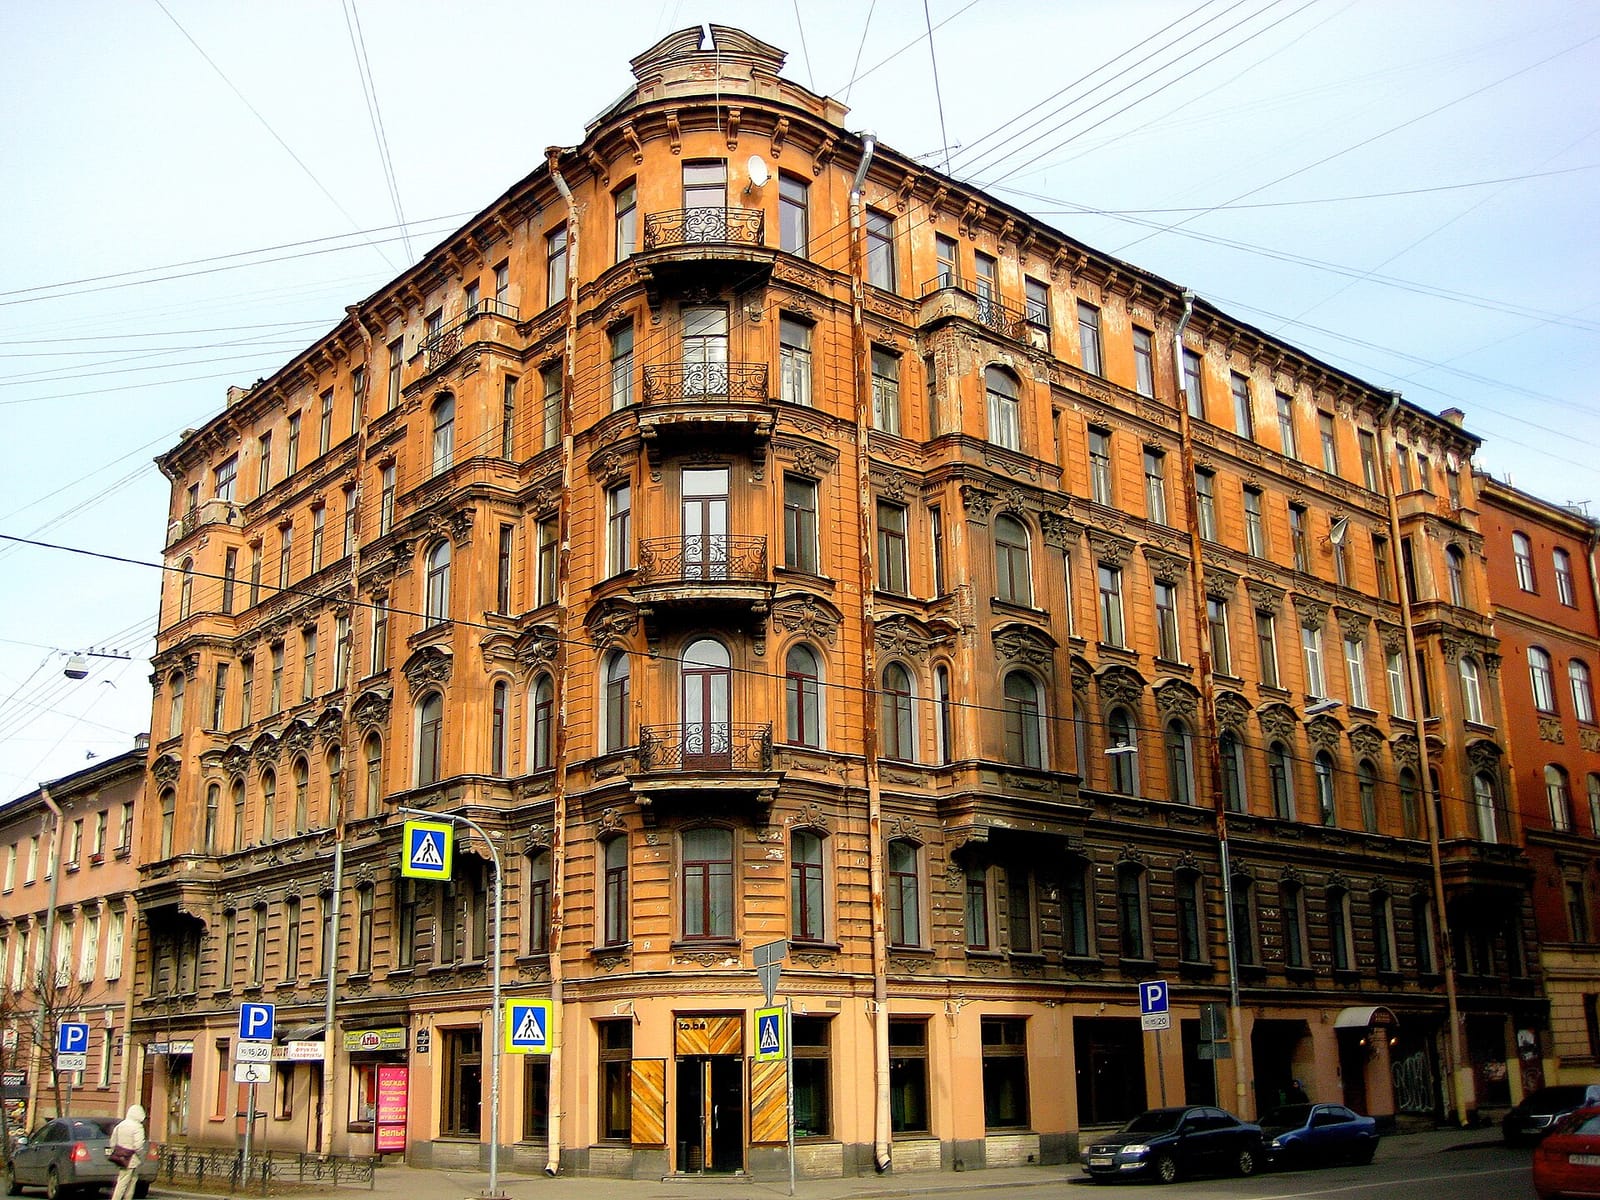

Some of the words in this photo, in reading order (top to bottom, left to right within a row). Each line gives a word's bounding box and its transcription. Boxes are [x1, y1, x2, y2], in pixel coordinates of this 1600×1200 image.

[1147, 985, 1162, 1010] P
[249, 1007, 269, 1036] P
[1158, 1017, 1167, 1025] 20
[66, 1026, 84, 1050] P
[256, 1048, 268, 1057] 20
[73, 1058, 83, 1066] 20
